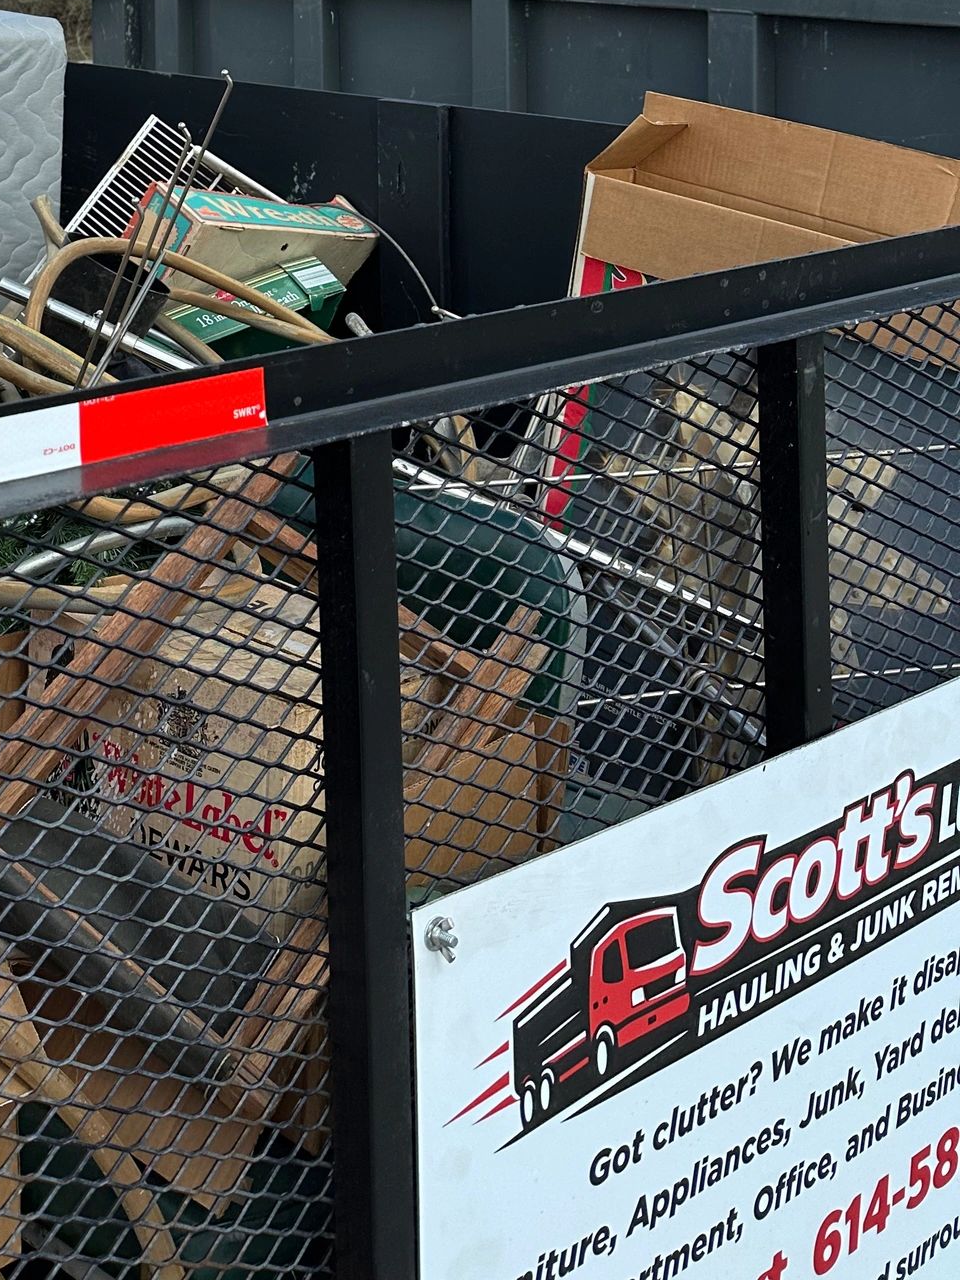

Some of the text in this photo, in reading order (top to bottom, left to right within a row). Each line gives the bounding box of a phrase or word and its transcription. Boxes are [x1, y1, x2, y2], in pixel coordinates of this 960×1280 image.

[200, 195, 336, 227] Wreath
[196, 314, 214, 328] 18
[43, 443, 76, 456] DOT-C2
[691, 773, 960, 975] Scott's L
[697, 943, 821, 1037] HAULING
[827, 932, 845, 964] &
[850, 890, 916, 952] JUNK
[588, 947, 960, 1187] Got clutter? We make it disa
[626, 1119, 792, 1239] Appliances,
[799, 1067, 865, 1129] Junk,
[875, 1020, 927, 1081] Yard
[931, 1000, 960, 1045] de
[753, 1151, 838, 1221] Office,
[845, 1103, 891, 1163] and
[896, 1064, 960, 1130] Busin
[813, 1126, 960, 1276] 614-58
